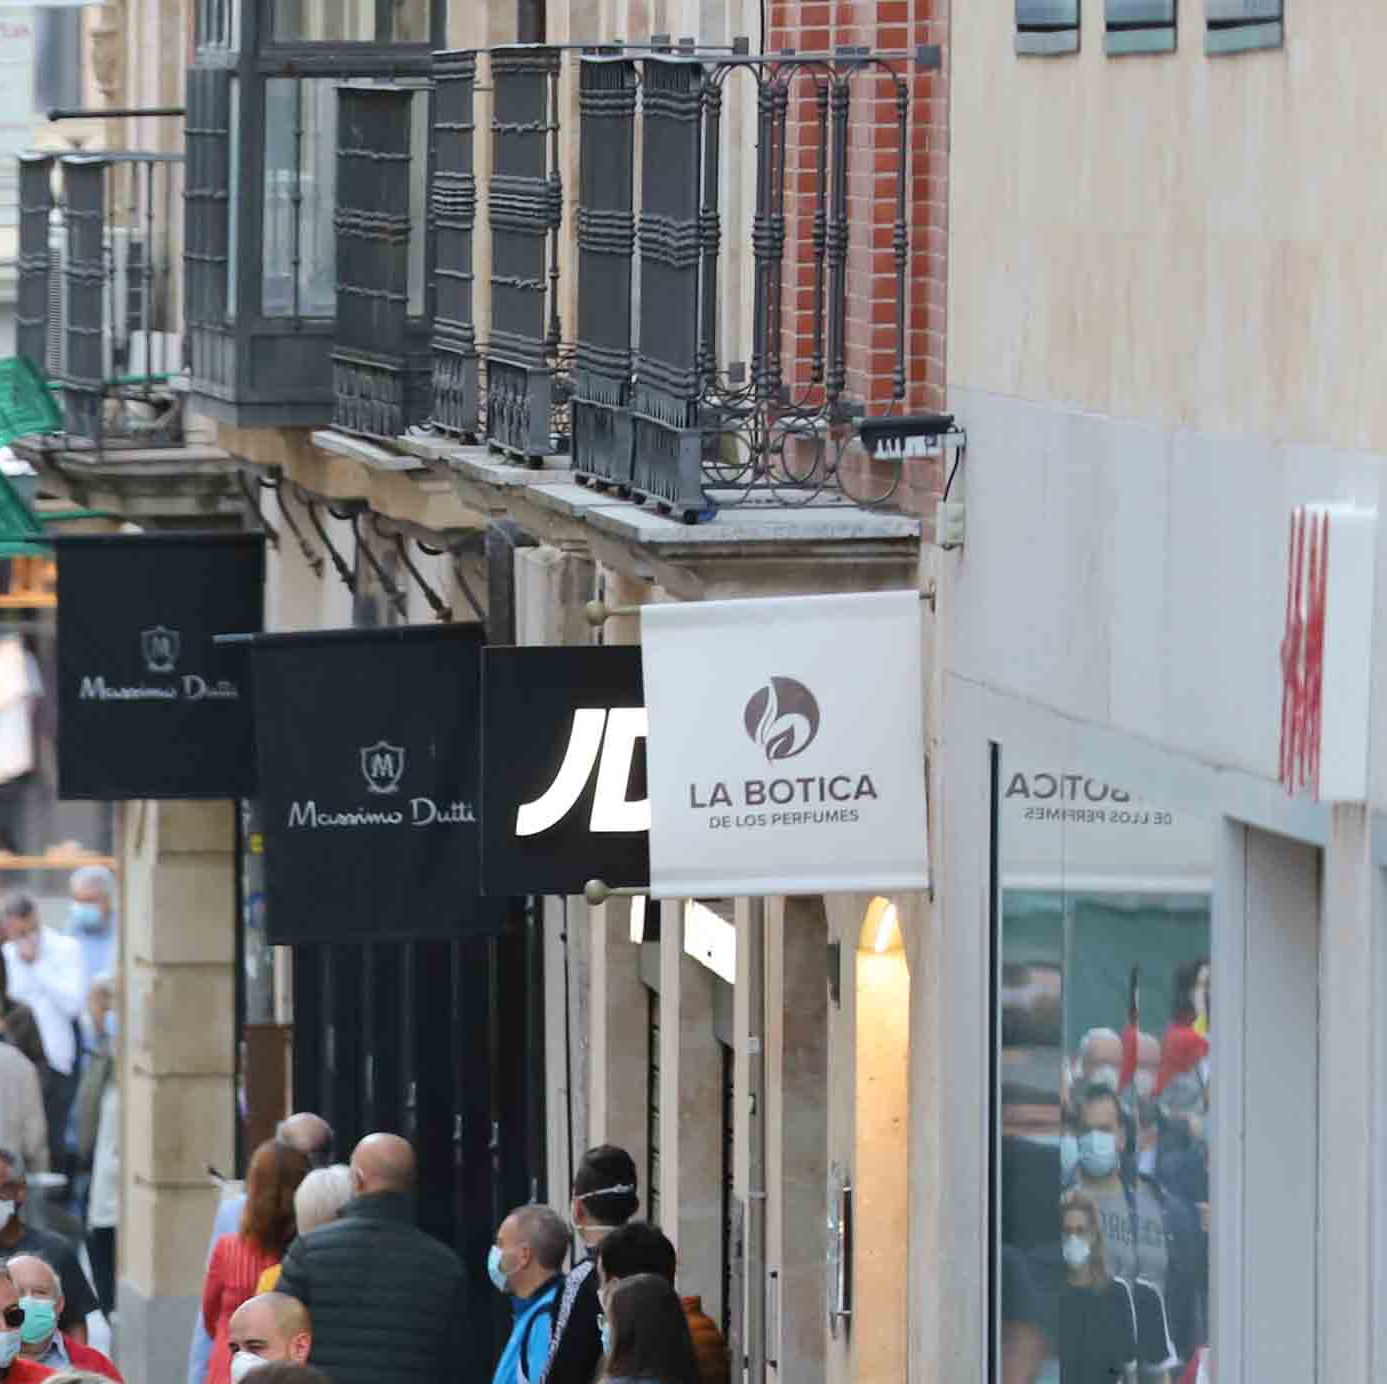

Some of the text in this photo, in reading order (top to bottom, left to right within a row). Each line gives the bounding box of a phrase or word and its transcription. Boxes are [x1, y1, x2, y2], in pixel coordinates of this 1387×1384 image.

[79, 676, 177, 699] Massimo
[515, 707, 651, 836] JD
[690, 775, 878, 808] LA BOTICA
[288, 797, 476, 827] Massimo Dutti
[709, 808, 860, 829] DE LOS PERFUMES
